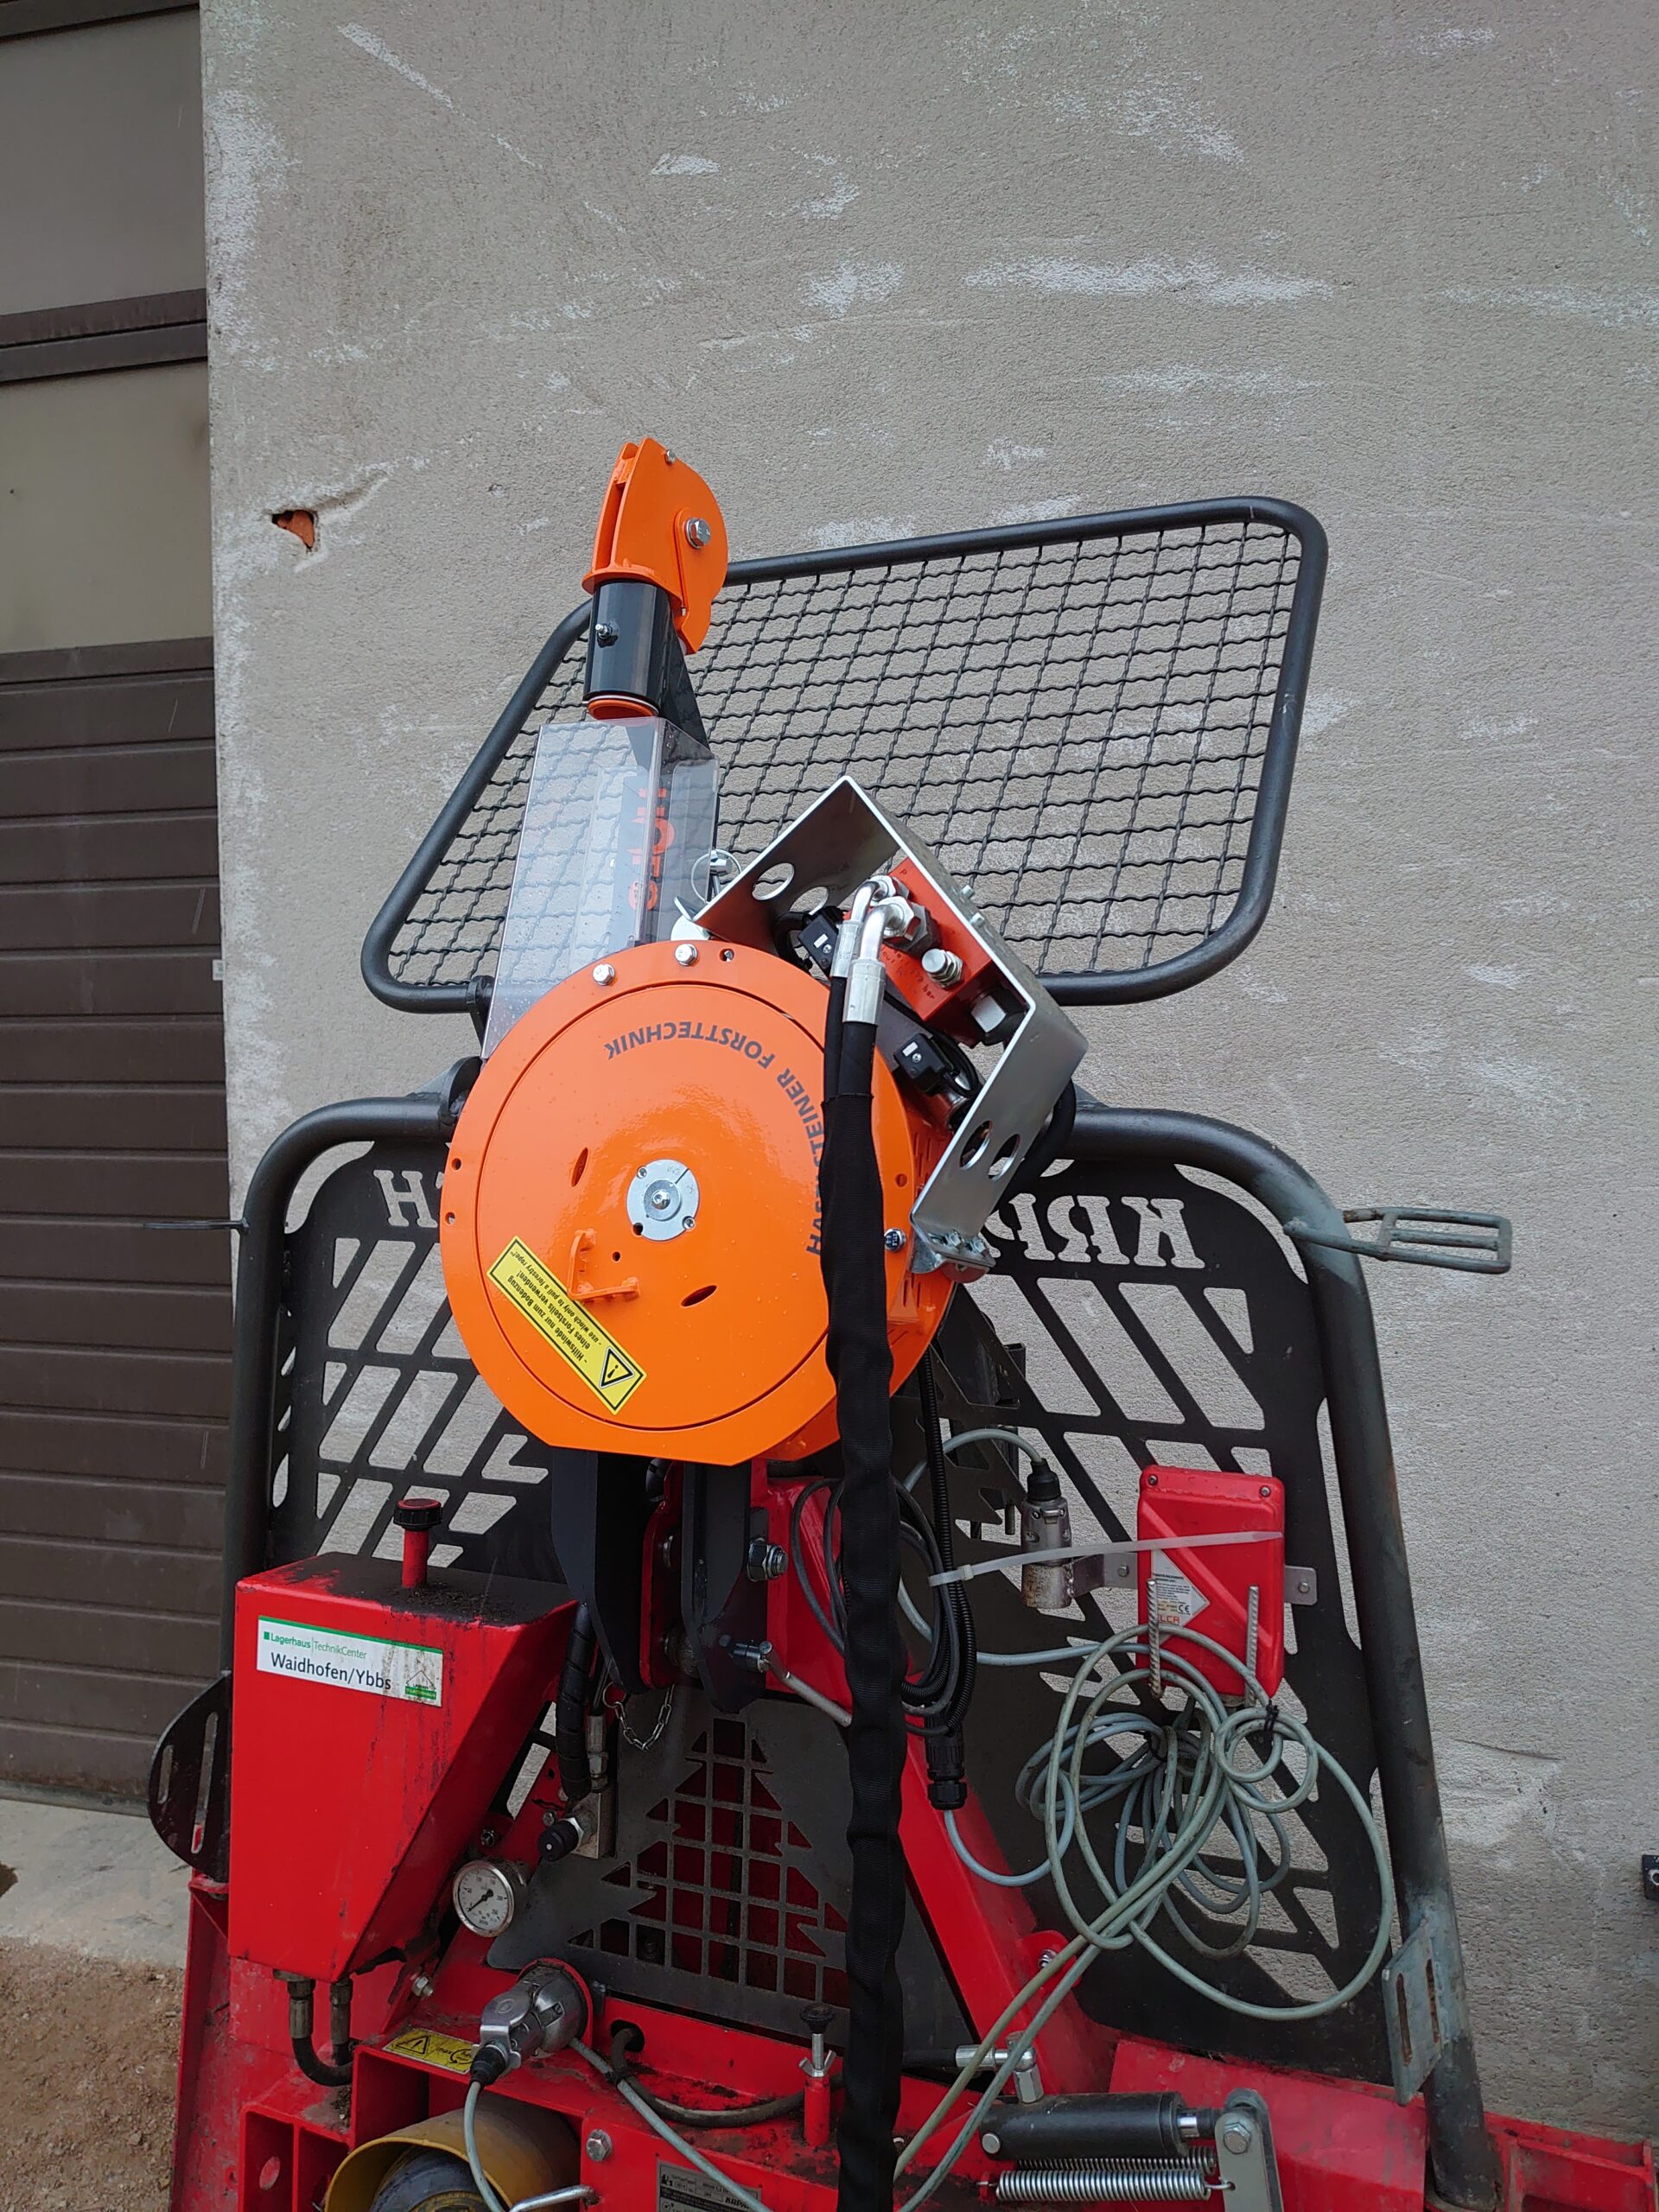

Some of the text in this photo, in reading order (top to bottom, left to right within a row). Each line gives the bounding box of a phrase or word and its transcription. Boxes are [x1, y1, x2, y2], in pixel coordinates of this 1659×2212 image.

[604, 1021, 775, 1070] FORSTTECHNIK
[524, 1264, 545, 1287] forestry
[506, 1274, 534, 1307] Bodenzug
[546, 1288, 561, 1300] pull
[516, 1270, 590, 1350] eines Forstseils verwenden!
[532, 1303, 546, 1318] zum
[557, 1298, 565, 1306] to
[563, 1304, 575, 1317] only
[543, 1316, 556, 1329] nur
[573, 1315, 589, 1333] winch
[554, 1326, 584, 1361] Hilfswinde
[588, 1331, 600, 1343] use
[271, 1632, 311, 1649] Lagerhaus
[271, 1651, 391, 1691] Waidhofen/Ybbs
